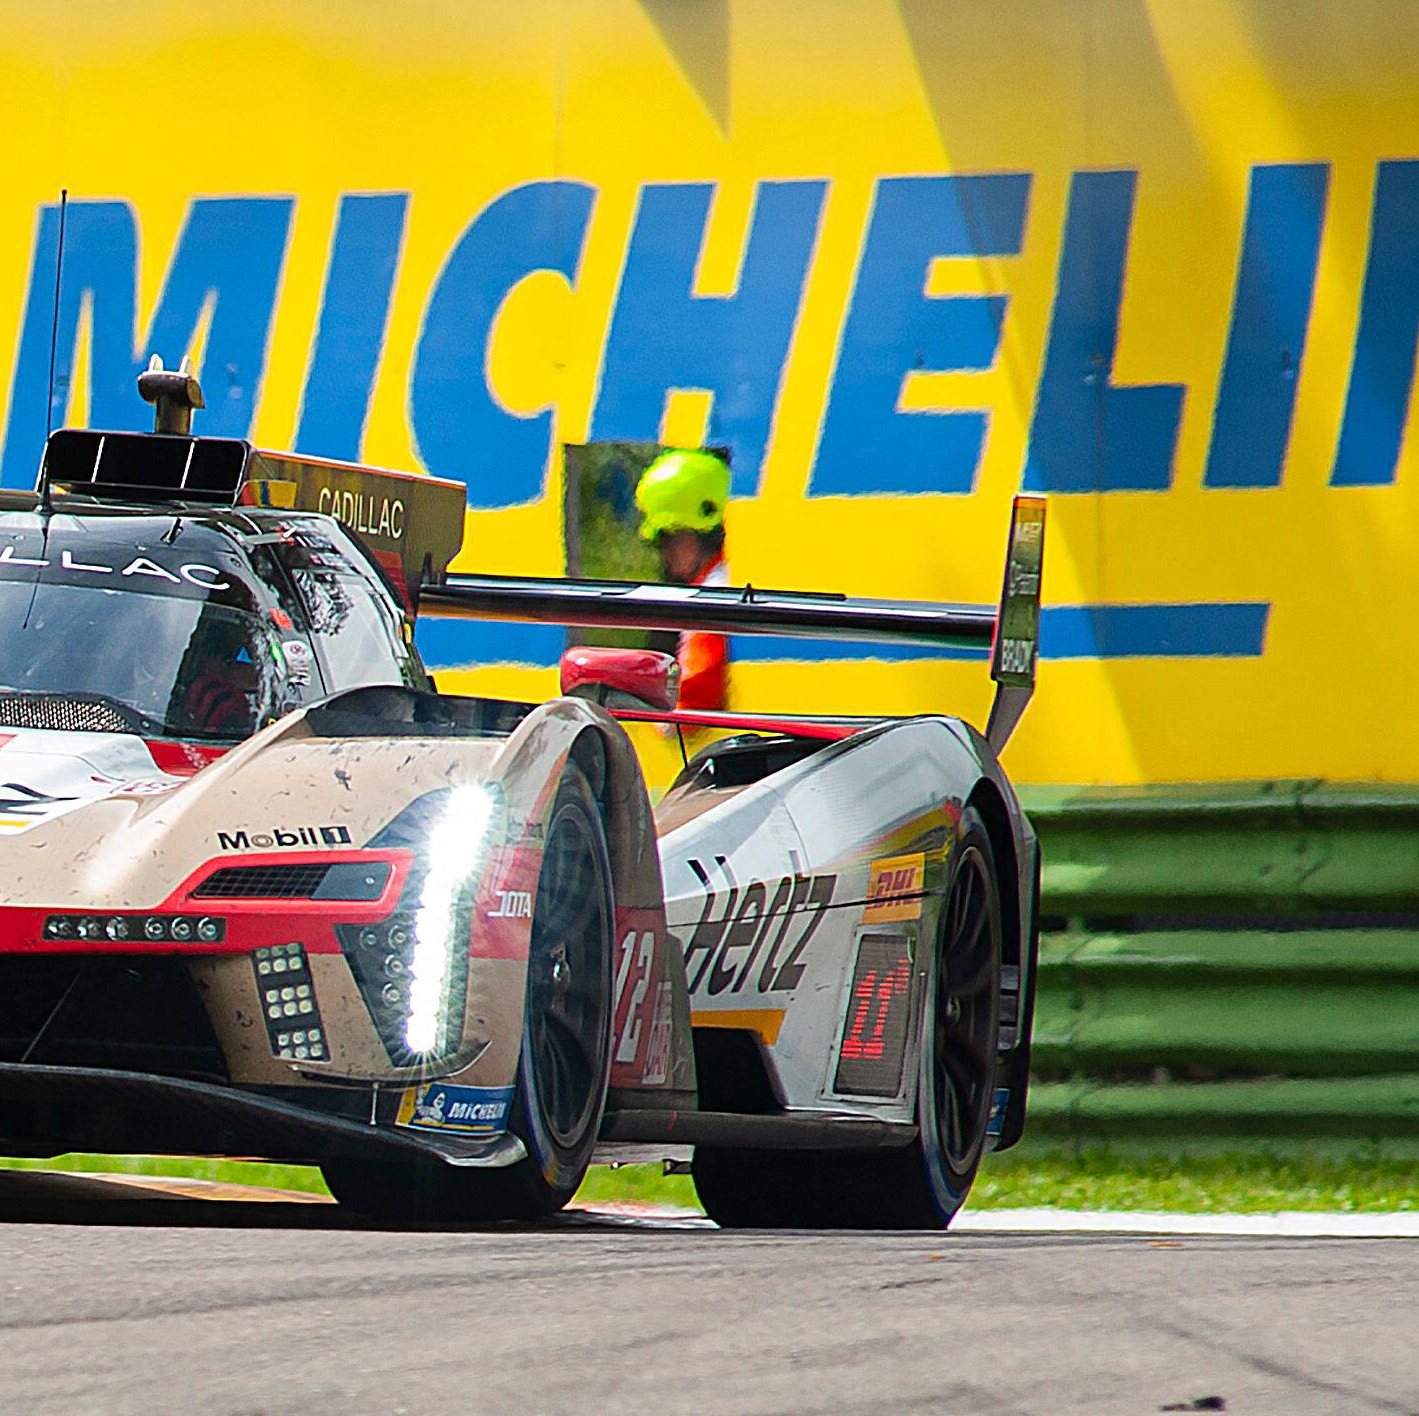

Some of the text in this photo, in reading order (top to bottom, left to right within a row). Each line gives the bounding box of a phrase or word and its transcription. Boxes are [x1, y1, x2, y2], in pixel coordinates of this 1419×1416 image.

[318, 488, 404, 539] CADILLAC
[217, 827, 318, 850] Mobil
[487, 890, 532, 918] JOTA
[683, 850, 839, 997] Hertz
[613, 930, 655, 1064] 12
[447, 1101, 507, 1121] MICHELIN
